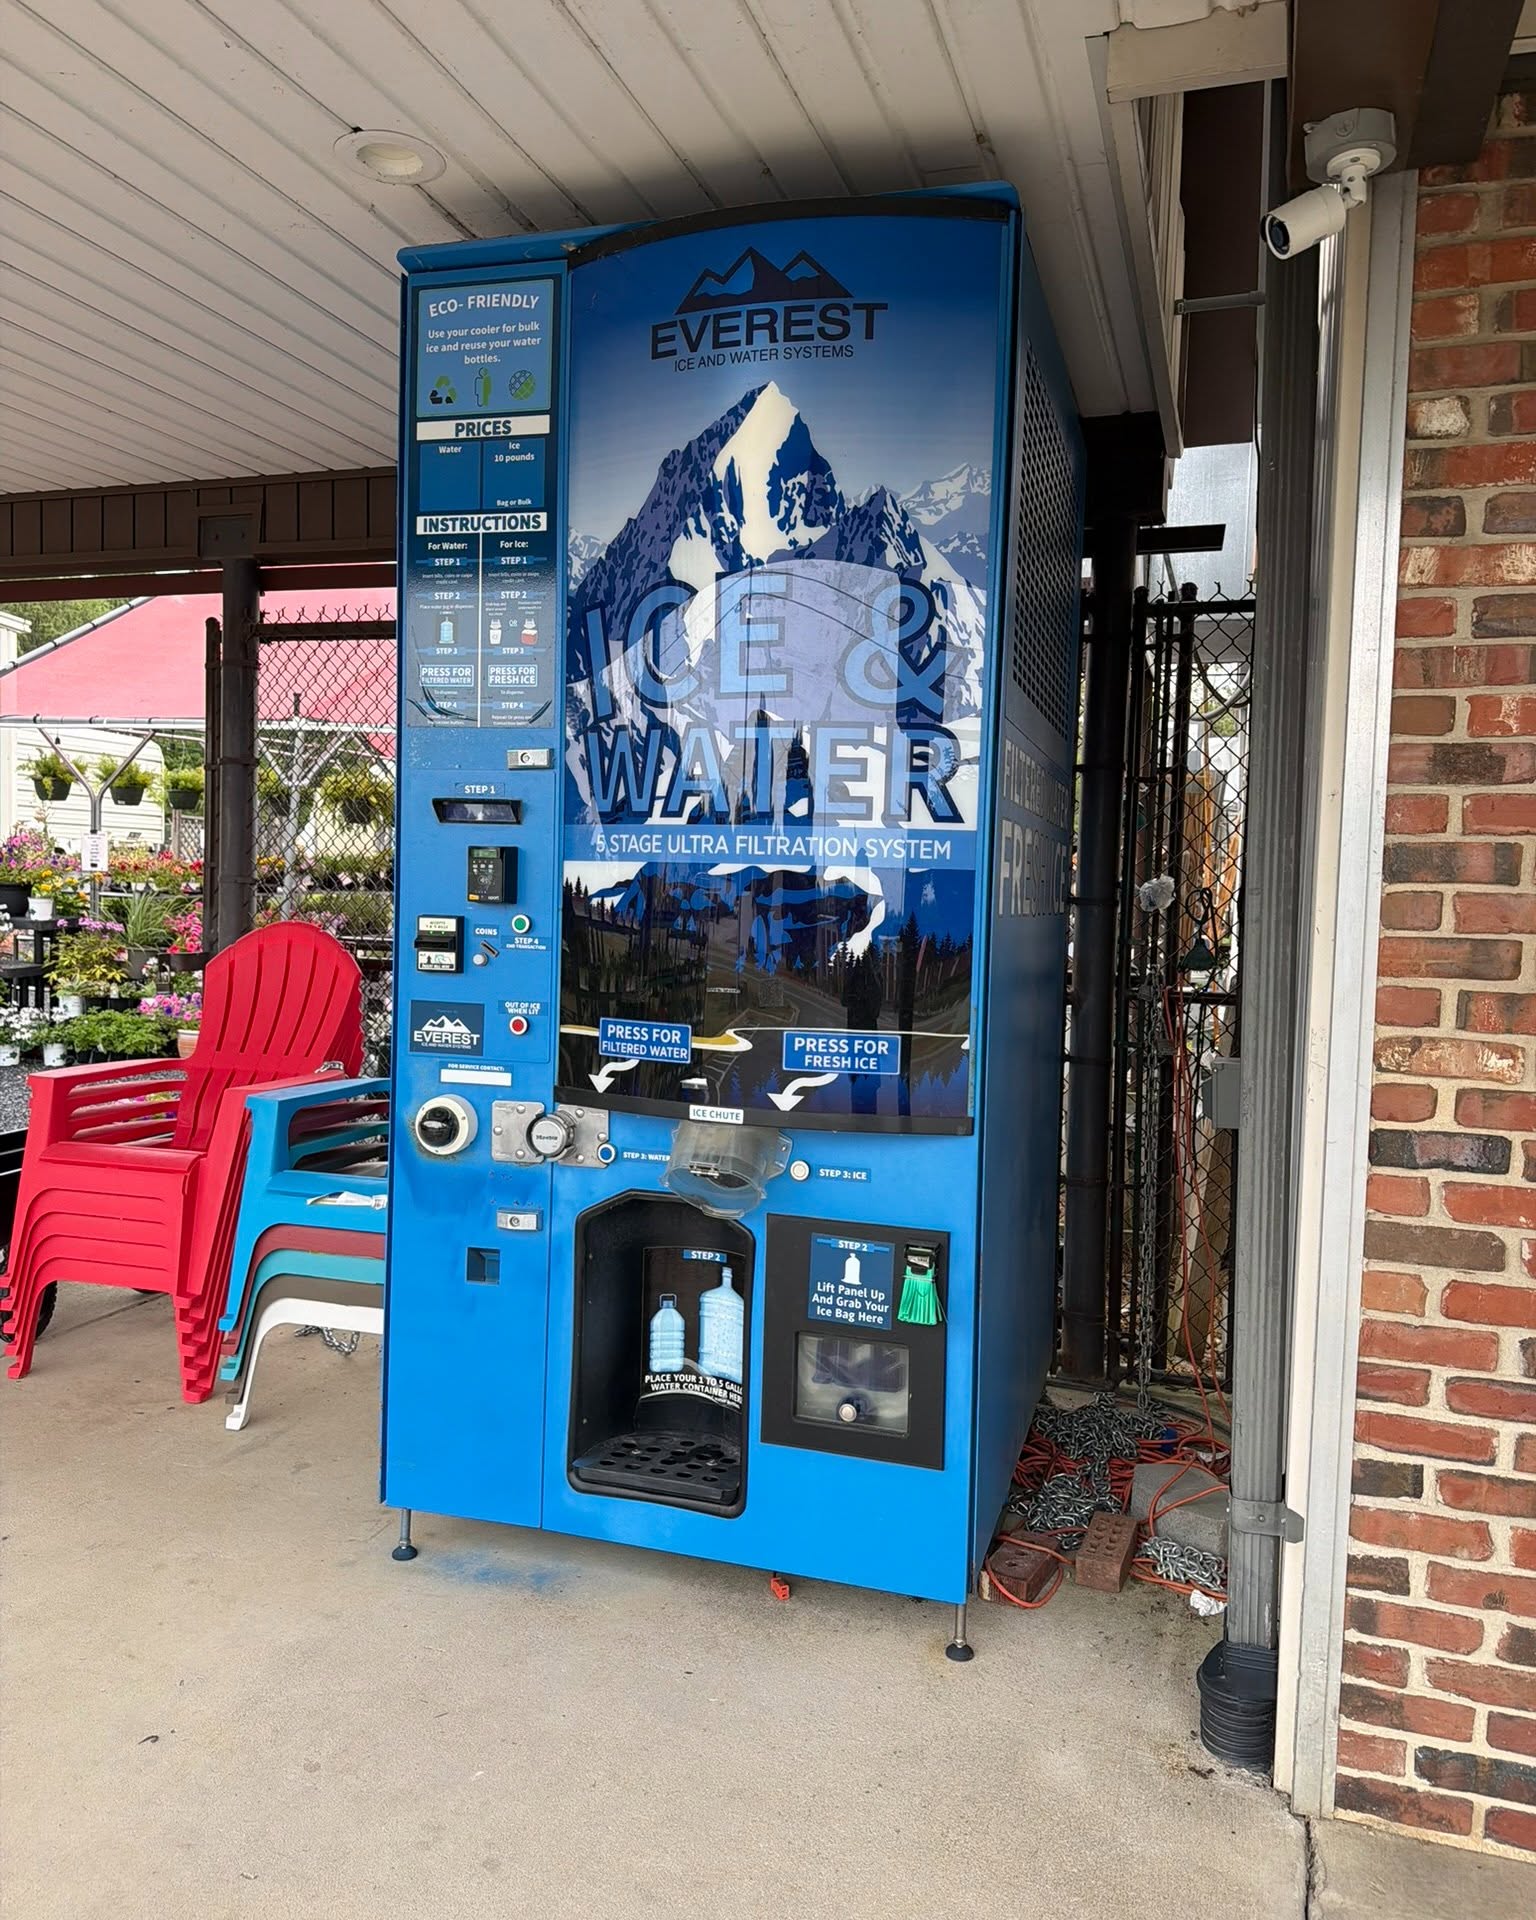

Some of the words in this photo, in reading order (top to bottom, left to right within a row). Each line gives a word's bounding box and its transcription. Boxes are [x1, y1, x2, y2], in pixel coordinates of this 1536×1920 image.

[429, 299, 464, 318] ECO-
[467, 293, 540, 310] FRIENDLY
[428, 329, 446, 340] Use
[447, 327, 469, 340] your
[470, 324, 500, 336] cooler
[502, 322, 517, 334] for
[518, 321, 540, 333] bulk
[650, 302, 888, 361] EVEREST
[426, 343, 439, 353] ice
[440, 341, 459, 352] and
[460, 340, 487, 351] reuse
[489, 339, 510, 352] your
[513, 336, 542, 347] water
[464, 353, 501, 365] bottles.
[674, 357, 696, 373] ICE
[697, 353, 726, 369] AND
[729, 348, 779, 365] WATER
[783, 344, 854, 360] SYSTEMS
[455, 420, 512, 437] PRICES
[438, 445, 462, 454] Water
[509, 442, 520, 450] Ice
[494, 454, 504, 462] 10
[505, 452, 535, 463] pounds
[496, 499, 508, 508] Bag
[517, 498, 532, 506] Bulk
[423, 514, 541, 533] INSTRUCTIONS
[428, 542, 440, 550] For
[441, 542, 468, 551] Water:
[500, 540, 512, 549] For
[513, 540, 529, 549] Ice:
[434, 558, 454, 566] STEP
[456, 558, 461, 566] 1
[501, 557, 520, 565] STEP
[434, 592, 454, 600] STEP
[455, 592, 460, 600] 2
[501, 591, 520, 599] STEP
[522, 591, 527, 599] 2
[584, 571, 793, 722] ICE
[840, 578, 966, 724] &
[422, 667, 451, 676] PRESS
[452, 667, 471, 676] FOR
[490, 667, 517, 675] PRESS
[518, 667, 535, 675] FOR
[490, 675, 519, 684] FRESH
[521, 675, 535, 684] ICE
[586, 721, 965, 827] WATER
[1003, 739, 1047, 818] FILTERED
[464, 785, 488, 794] STEP
[490, 785, 496, 794] 1
[596, 834, 606, 853] 5
[609, 834, 663, 853] STAGE
[667, 834, 728, 855] ULTRA
[735, 835, 857, 858] FILTRATION
[865, 838, 951, 860] SYSTEM
[475, 927, 498, 936] COINS
[505, 1001, 518, 1009] OUT
[530, 1002, 541, 1010] ICE
[413, 1030, 481, 1046] EVEREST
[607, 1026, 649, 1042] PRESS
[652, 1029, 681, 1044] FOR
[602, 1040, 647, 1055] FILTERED
[650, 1045, 687, 1060] WATER
[794, 1038, 849, 1054] PRESS
[853, 1039, 889, 1055] FOR
[804, 1055, 852, 1069] FRESH
[855, 1057, 878, 1070] ICE
[692, 1108, 707, 1118] ICE
[709, 1110, 741, 1121] CHUTE
[641, 1152, 647, 1160] 3:
[819, 1168, 841, 1179] STEP
[844, 1170, 851, 1179] 3:
[852, 1171, 867, 1180] ICE
[838, 1240, 860, 1250] STEP
[862, 1242, 868, 1251] 2
[691, 1251, 713, 1260] STEP
[715, 1252, 720, 1261] 2
[817, 1281, 835, 1294] Lift
[838, 1285, 867, 1298] Panel
[871, 1289, 885, 1302] Up
[812, 1294, 833, 1306] And
[836, 1297, 861, 1309] Grab
[865, 1301, 889, 1313] Your
[816, 1306, 831, 1317] Ice
[835, 1309, 855, 1323] Bag
[858, 1312, 883, 1324] Here
[645, 1374, 671, 1384] PLACE
[673, 1374, 697, 1383] YOUR
[698, 1376, 704, 1385] 1
[705, 1377, 717, 1387] TO
[719, 1379, 724, 1387] 5
[651, 1382, 681, 1391] WATER
[683, 1383, 728, 1398] CONTAINER
[729, 1391, 743, 1404] HER
